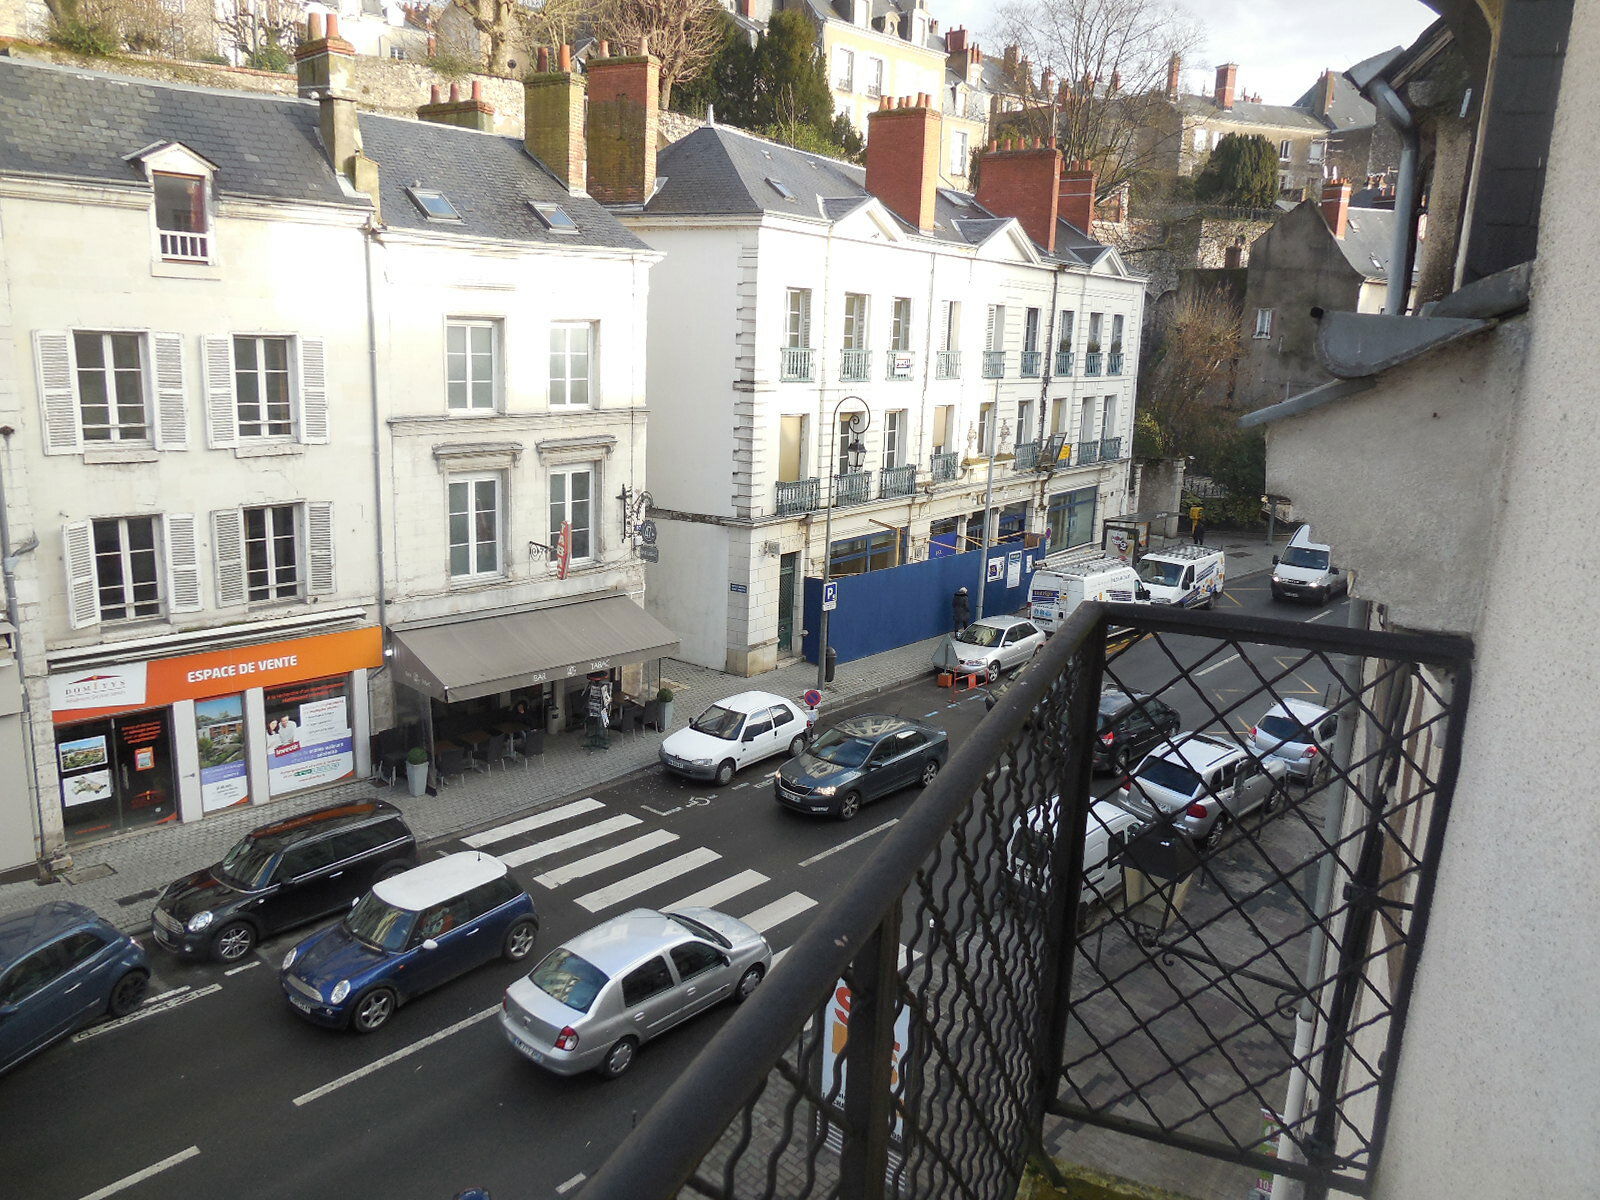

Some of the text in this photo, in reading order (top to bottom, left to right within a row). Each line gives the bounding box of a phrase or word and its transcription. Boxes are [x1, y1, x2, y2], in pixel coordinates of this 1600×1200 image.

[828, 587, 833, 600] P
[187, 655, 298, 682] ESPACE DE VENTE
[533, 673, 547, 682] BAR
[591, 659, 610, 670] TABAC
